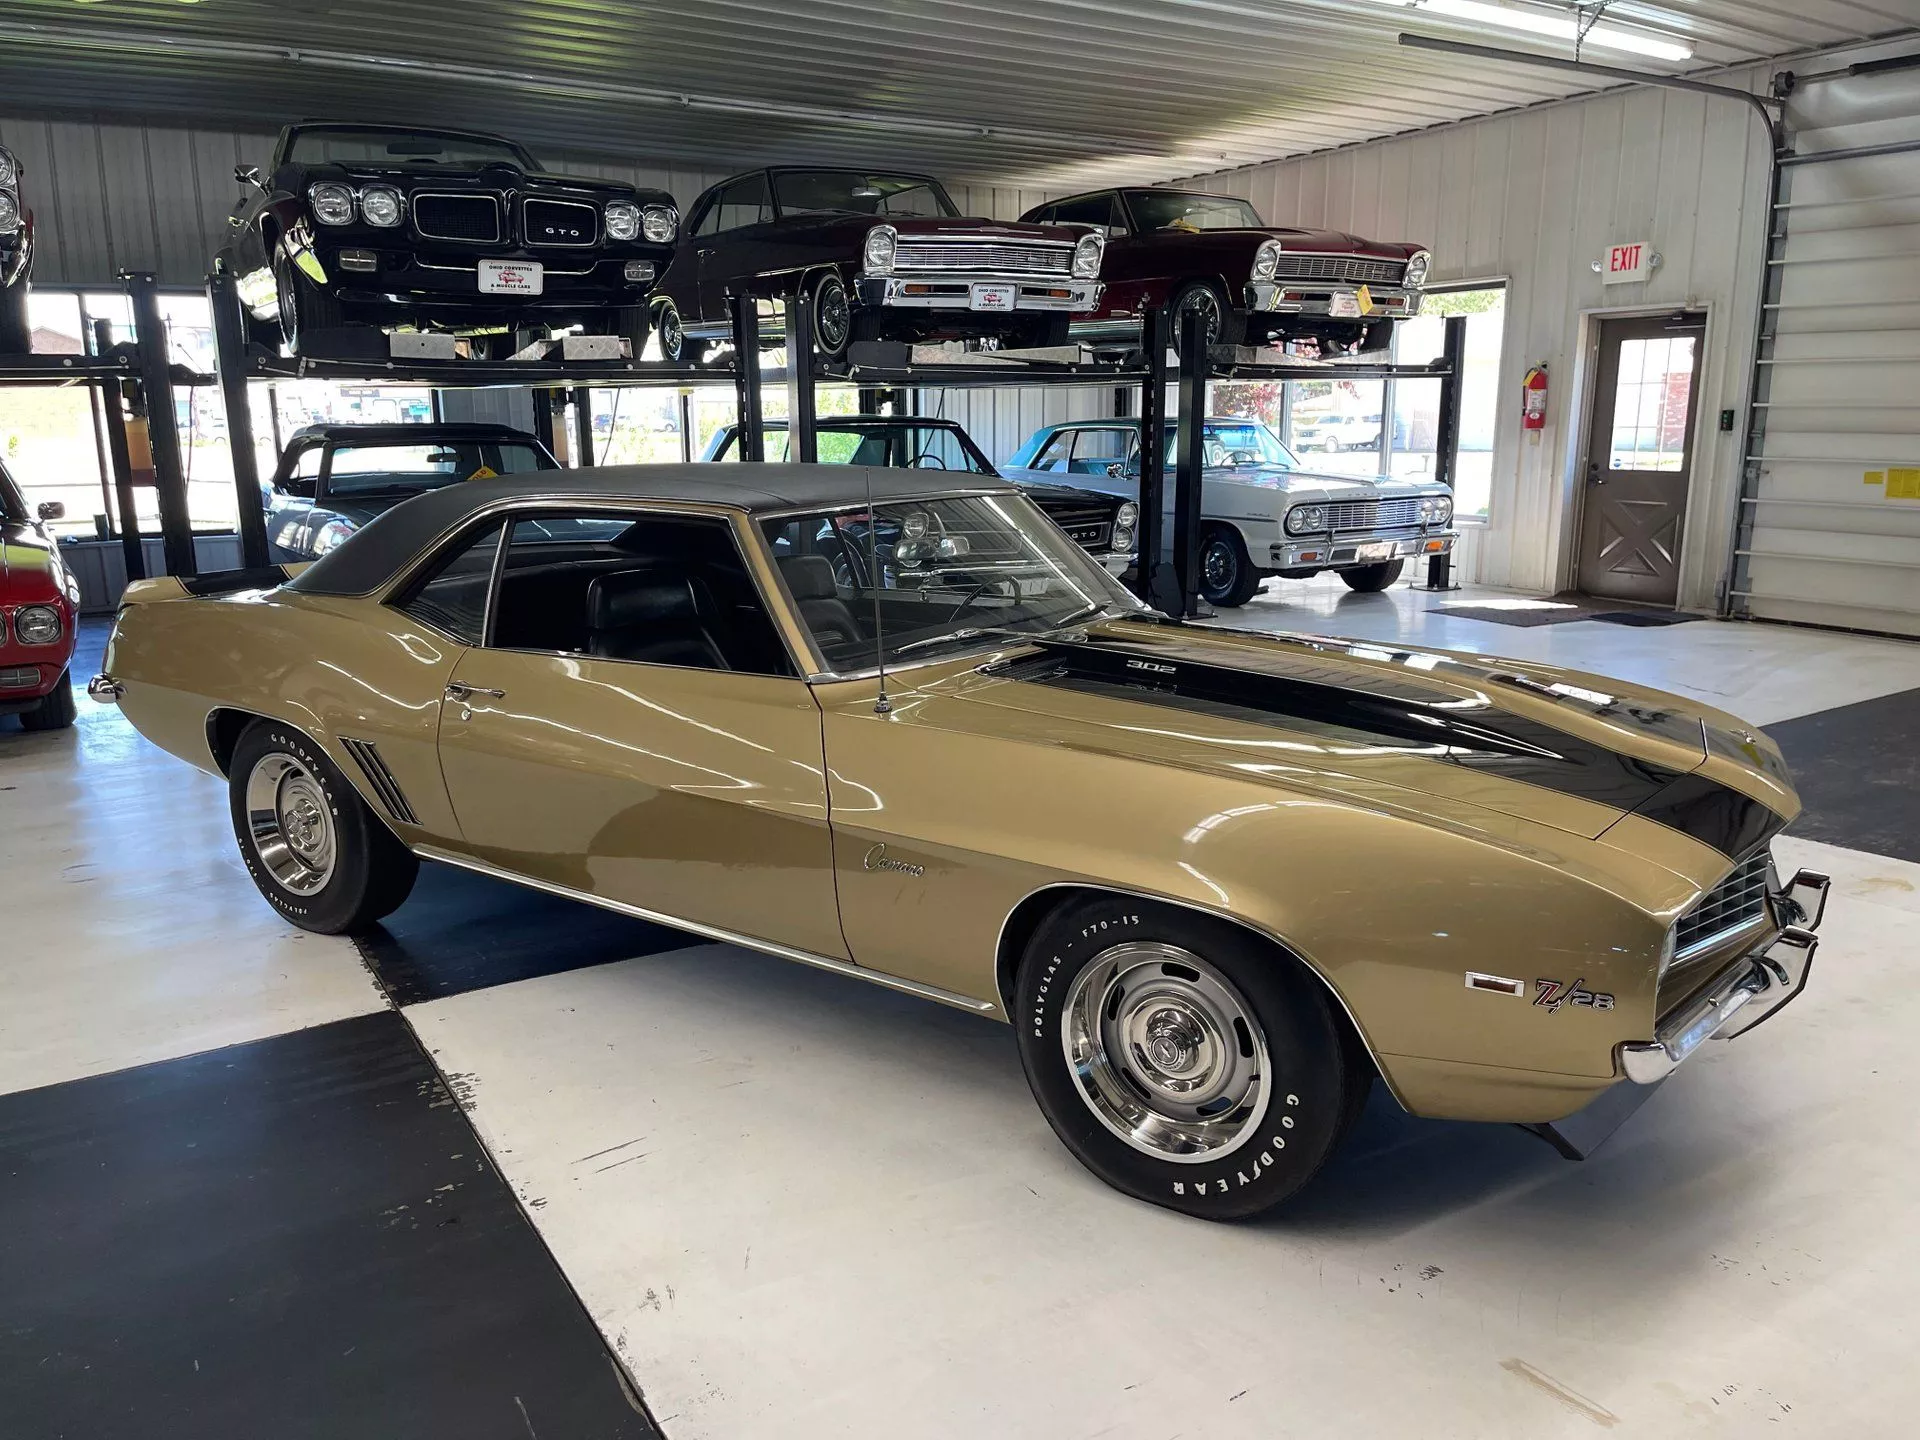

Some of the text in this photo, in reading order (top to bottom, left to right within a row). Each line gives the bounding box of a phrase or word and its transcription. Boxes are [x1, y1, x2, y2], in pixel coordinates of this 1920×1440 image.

[545, 227, 579, 236] GTO
[1611, 245, 1642, 272] EXIT
[1126, 659, 1177, 675] 302
[271, 733, 338, 816] GOODYEAR
[863, 842, 925, 877] Camaro
[1034, 955, 1062, 1038] POLYGLAS
[1081, 915, 1140, 938] F70-15
[1532, 978, 1616, 1015] Z/28
[1173, 1093, 1300, 1196] GOODYEAR
